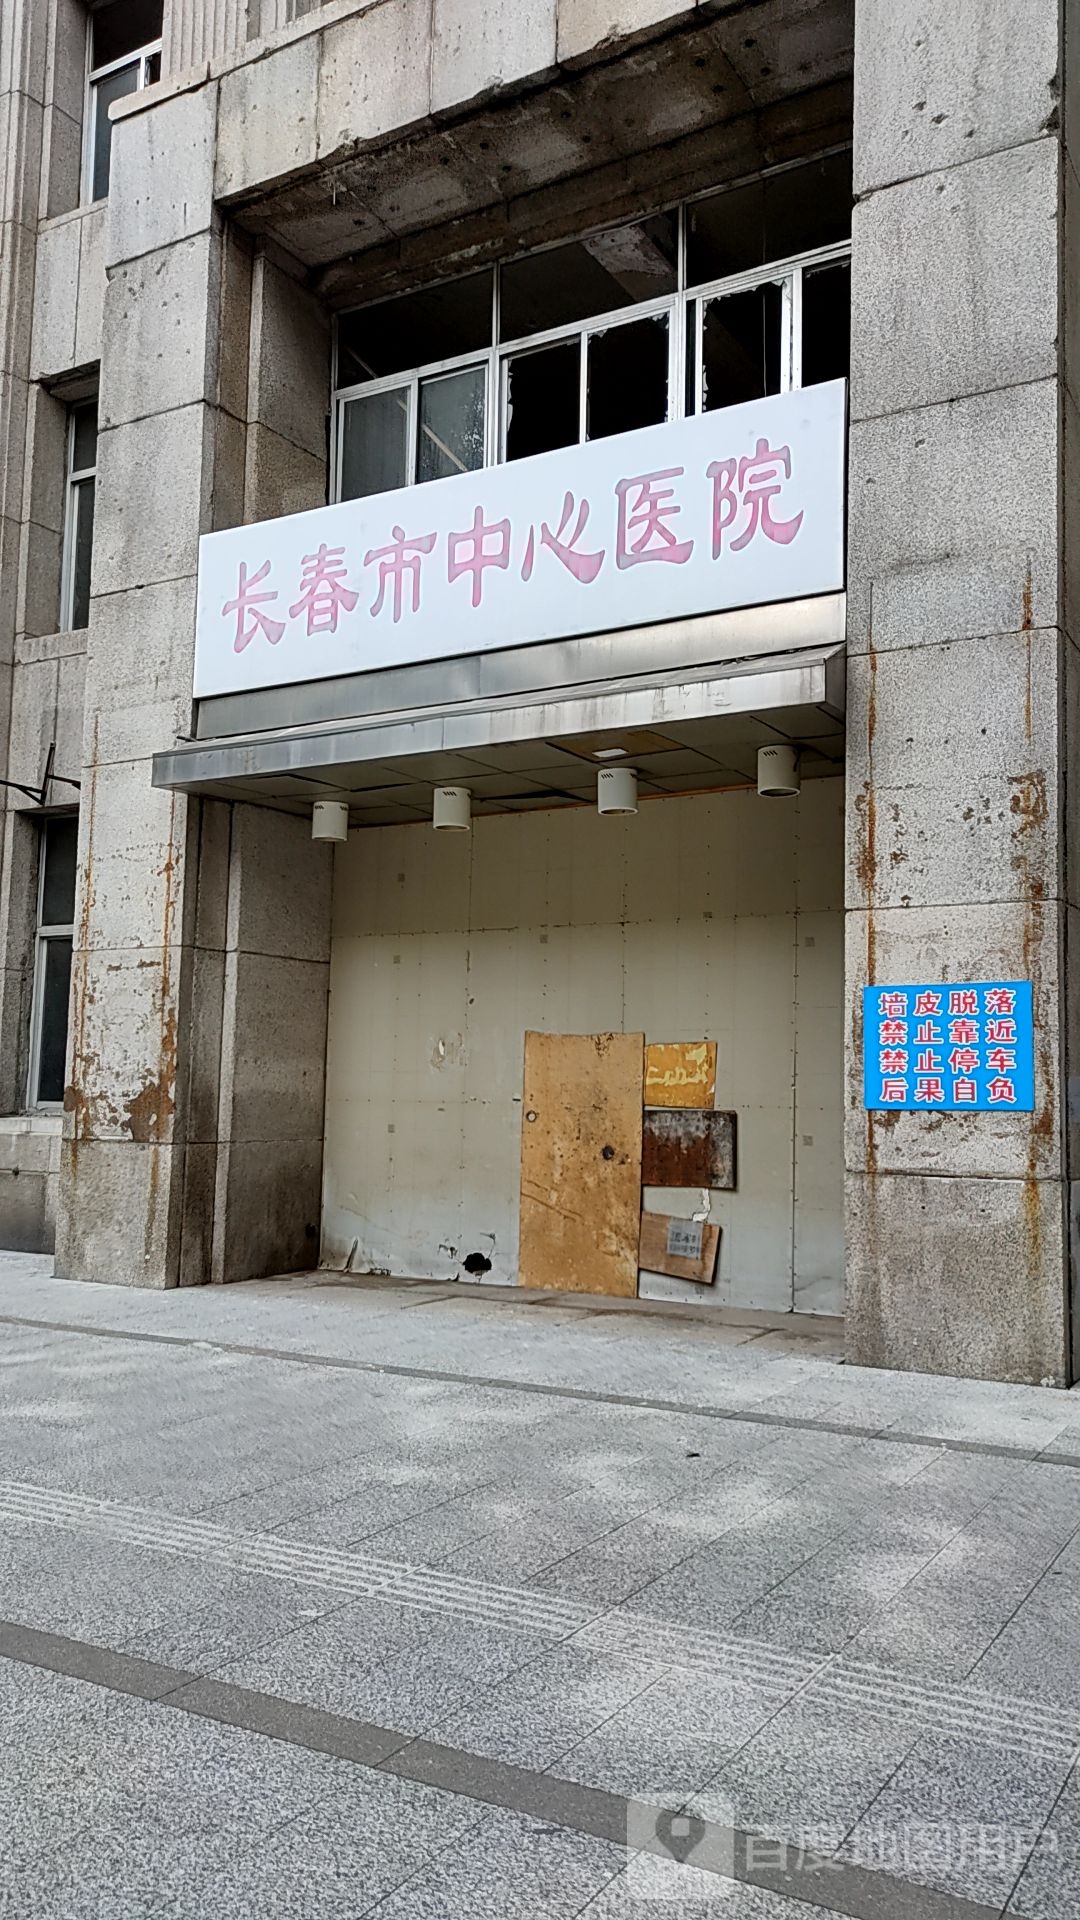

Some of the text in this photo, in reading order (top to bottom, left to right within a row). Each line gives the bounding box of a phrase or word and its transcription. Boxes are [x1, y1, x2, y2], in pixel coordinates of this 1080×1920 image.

[222, 438, 804, 654] 长春市中心医院
[879, 989, 1016, 1017] 墙皮脱落
[879, 1019, 1016, 1045] 禁止靠近
[879, 1047, 1017, 1074] 禁止停车
[880, 1077, 1017, 1104] 后果自负
